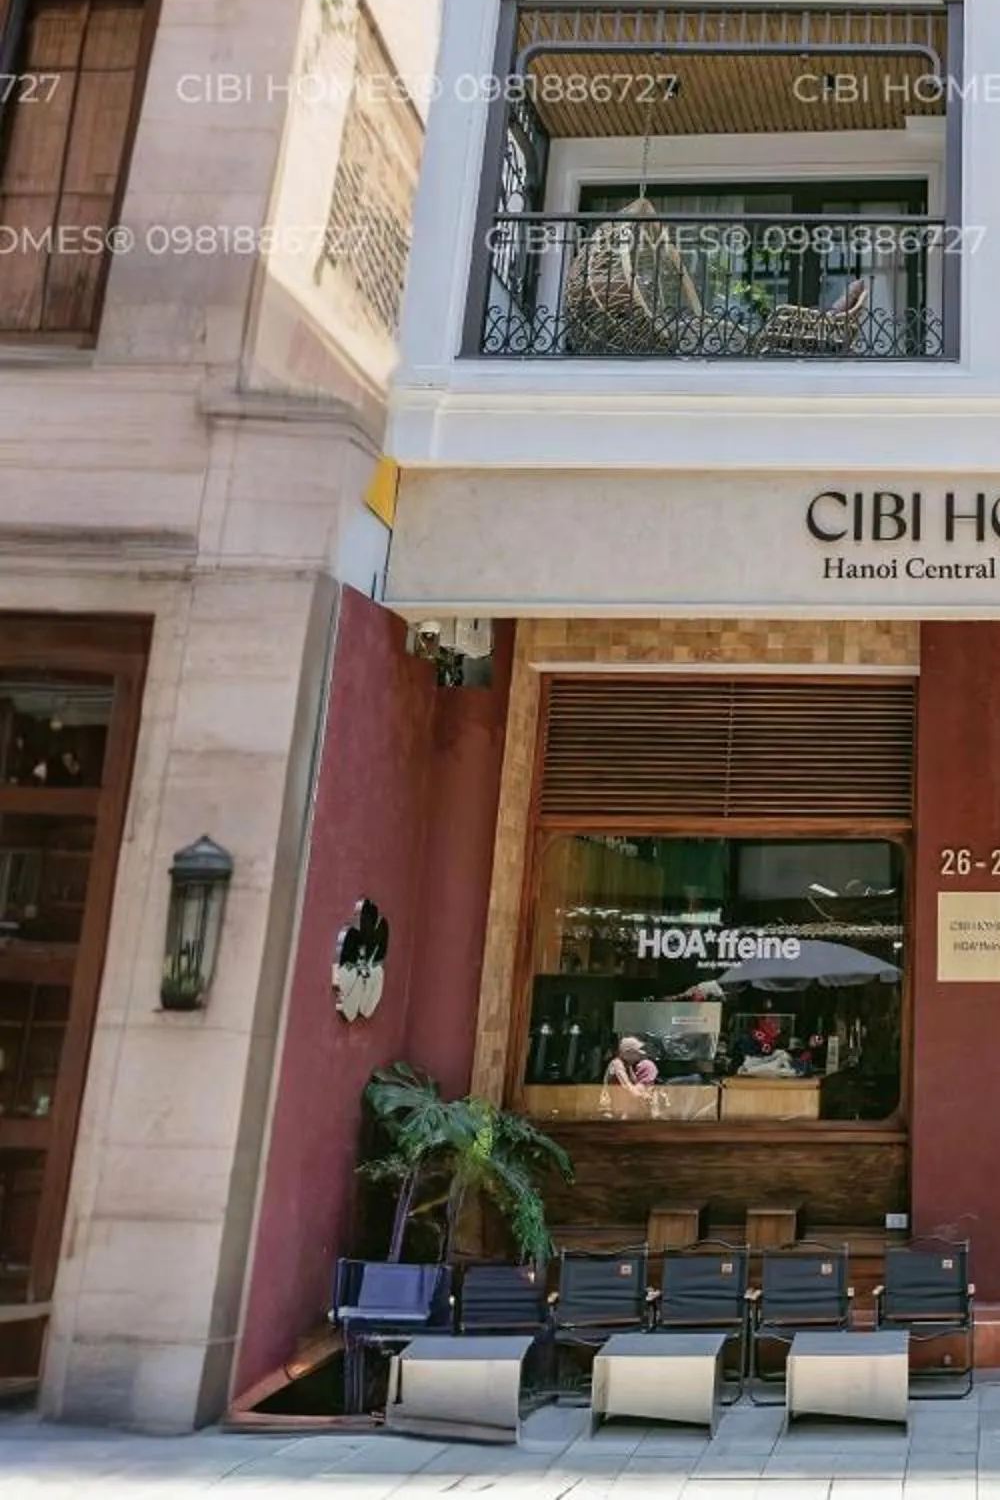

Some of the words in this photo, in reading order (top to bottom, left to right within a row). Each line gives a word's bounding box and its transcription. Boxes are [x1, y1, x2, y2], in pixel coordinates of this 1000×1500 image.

[806, 491, 921, 543] CIBI
[822, 557, 898, 580] Hanoi
[905, 557, 996, 580] Central
